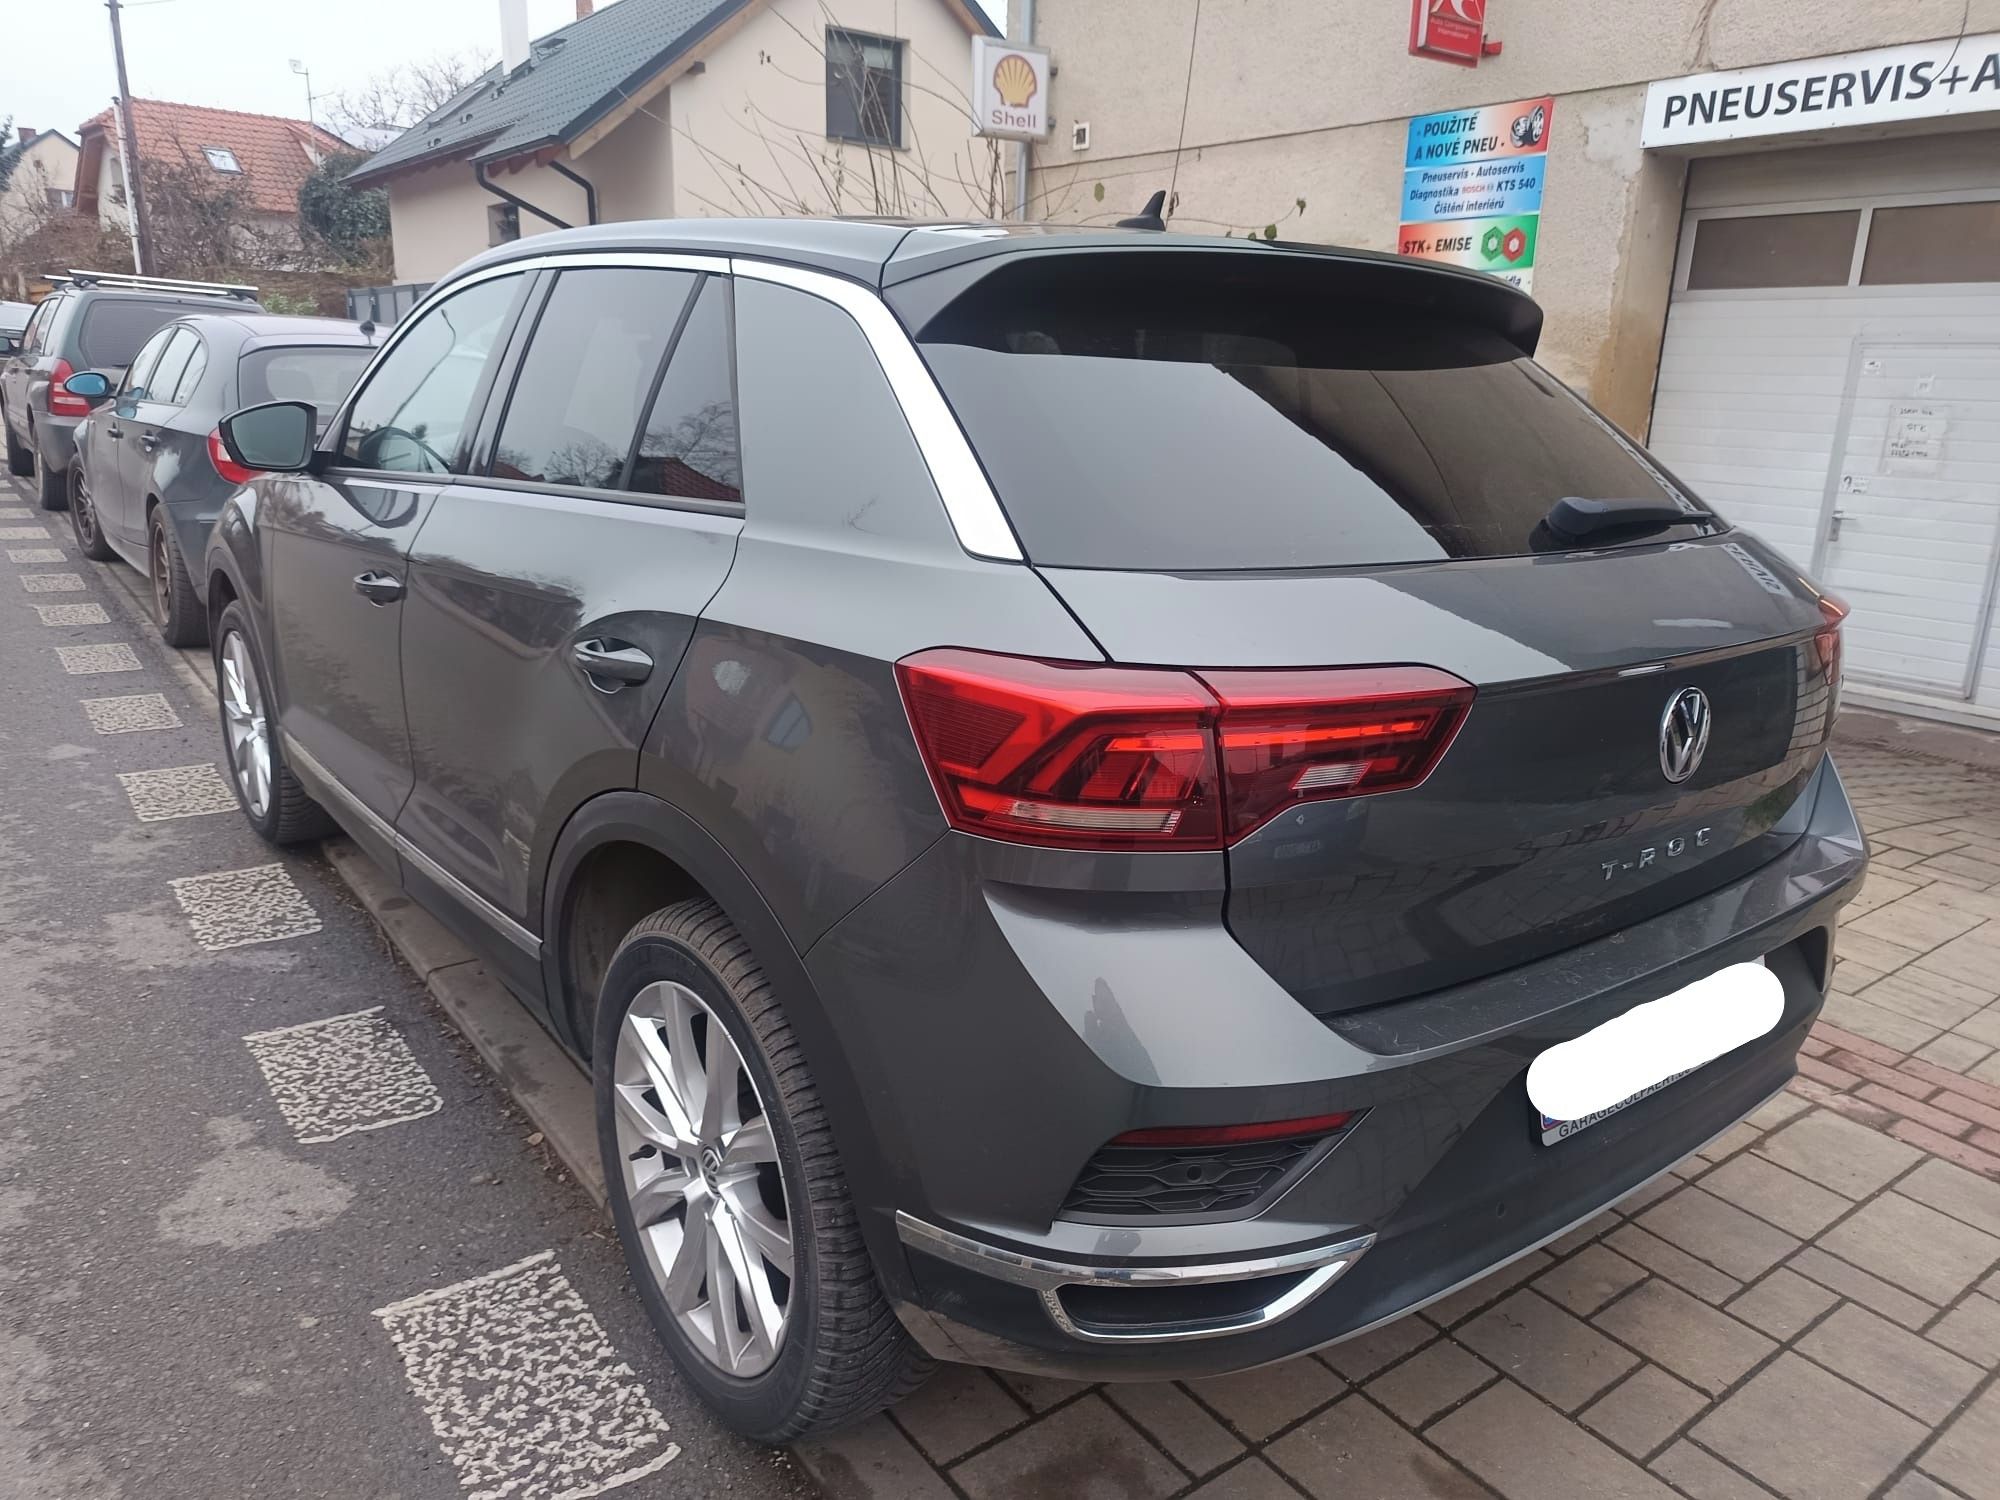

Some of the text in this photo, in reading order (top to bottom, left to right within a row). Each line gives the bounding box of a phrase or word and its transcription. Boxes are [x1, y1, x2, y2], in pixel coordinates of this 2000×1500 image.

[992, 110, 1036, 128] Shell
[1415, 136, 1498, 161] A NOVÉ PNEU
[1422, 169, 1469, 184] Pneuservis
[1476, 161, 1525, 178] Autoservis
[1410, 186, 1459, 202] Diagnostika
[1496, 180, 1516, 192] KTS
[1518, 177, 1536, 190] 540
[1435, 237, 1472, 252] EMISE
[1601, 828, 1711, 880] T-ROC
